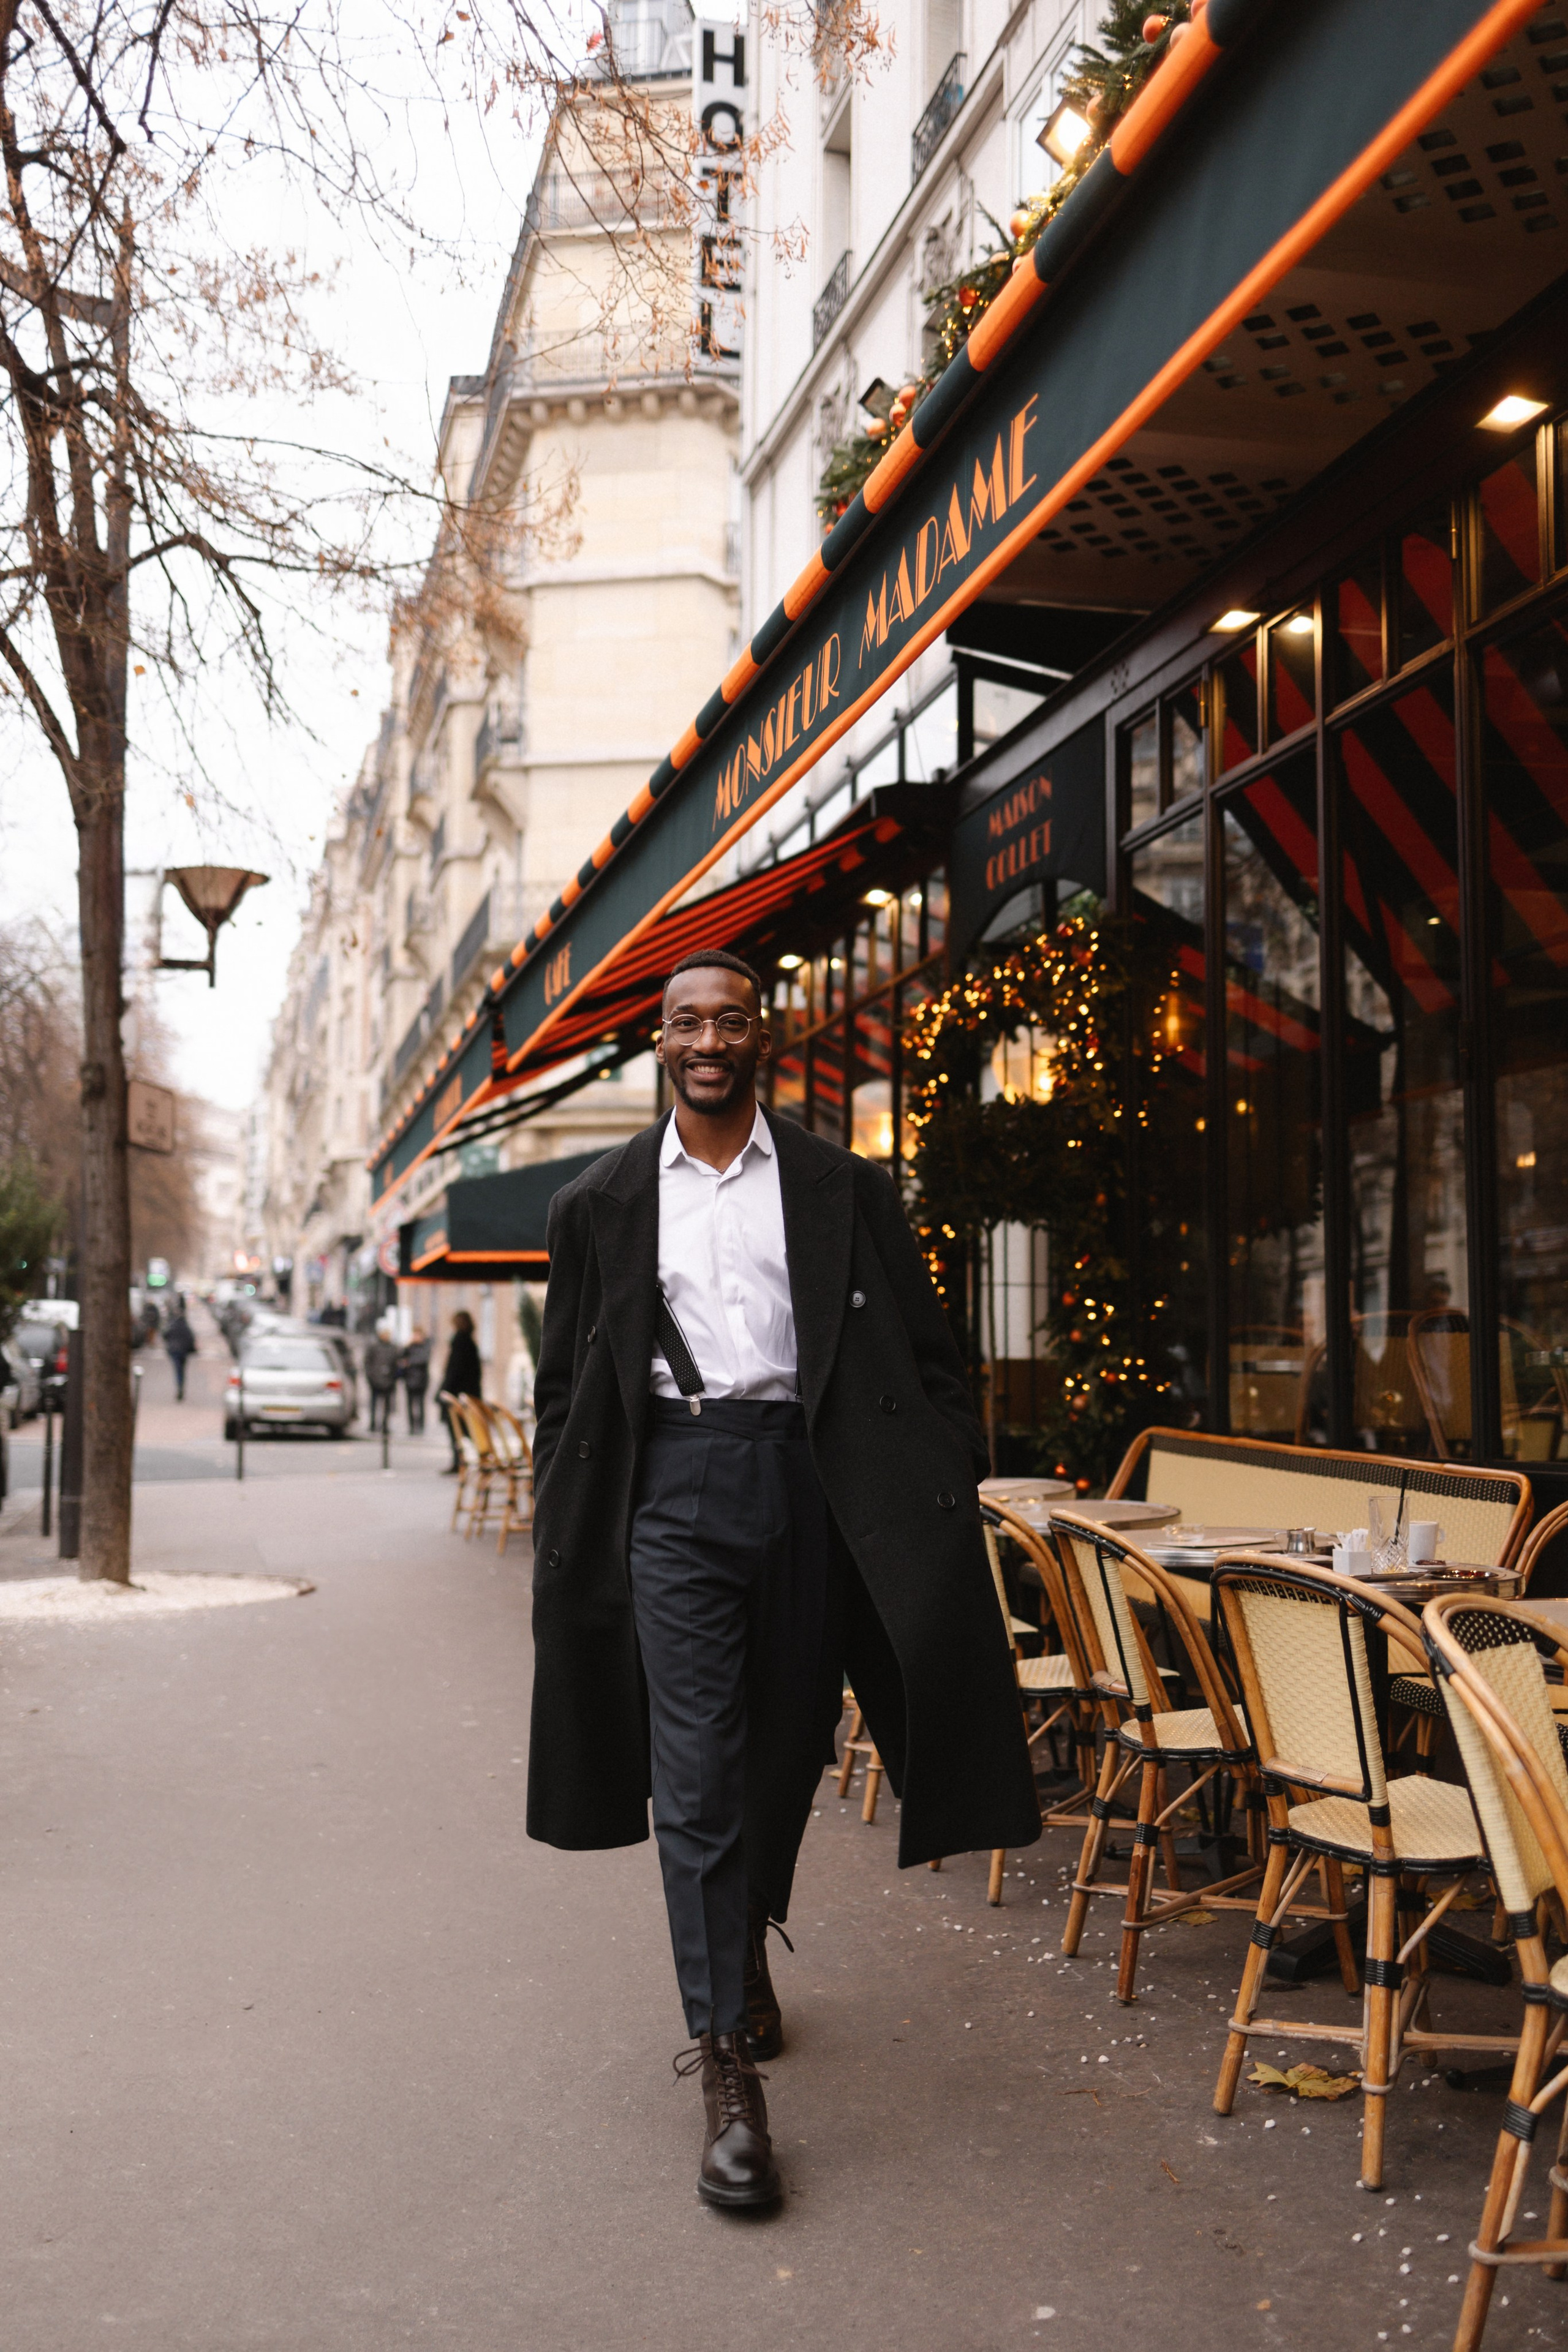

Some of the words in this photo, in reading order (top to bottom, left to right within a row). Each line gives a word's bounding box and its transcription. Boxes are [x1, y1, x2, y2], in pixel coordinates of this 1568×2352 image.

[700, 29, 745, 360] HOTEL
[712, 633, 840, 832] MONSIEUR
[859, 393, 1038, 669] MADAME
[987, 770, 1052, 842] MAISON
